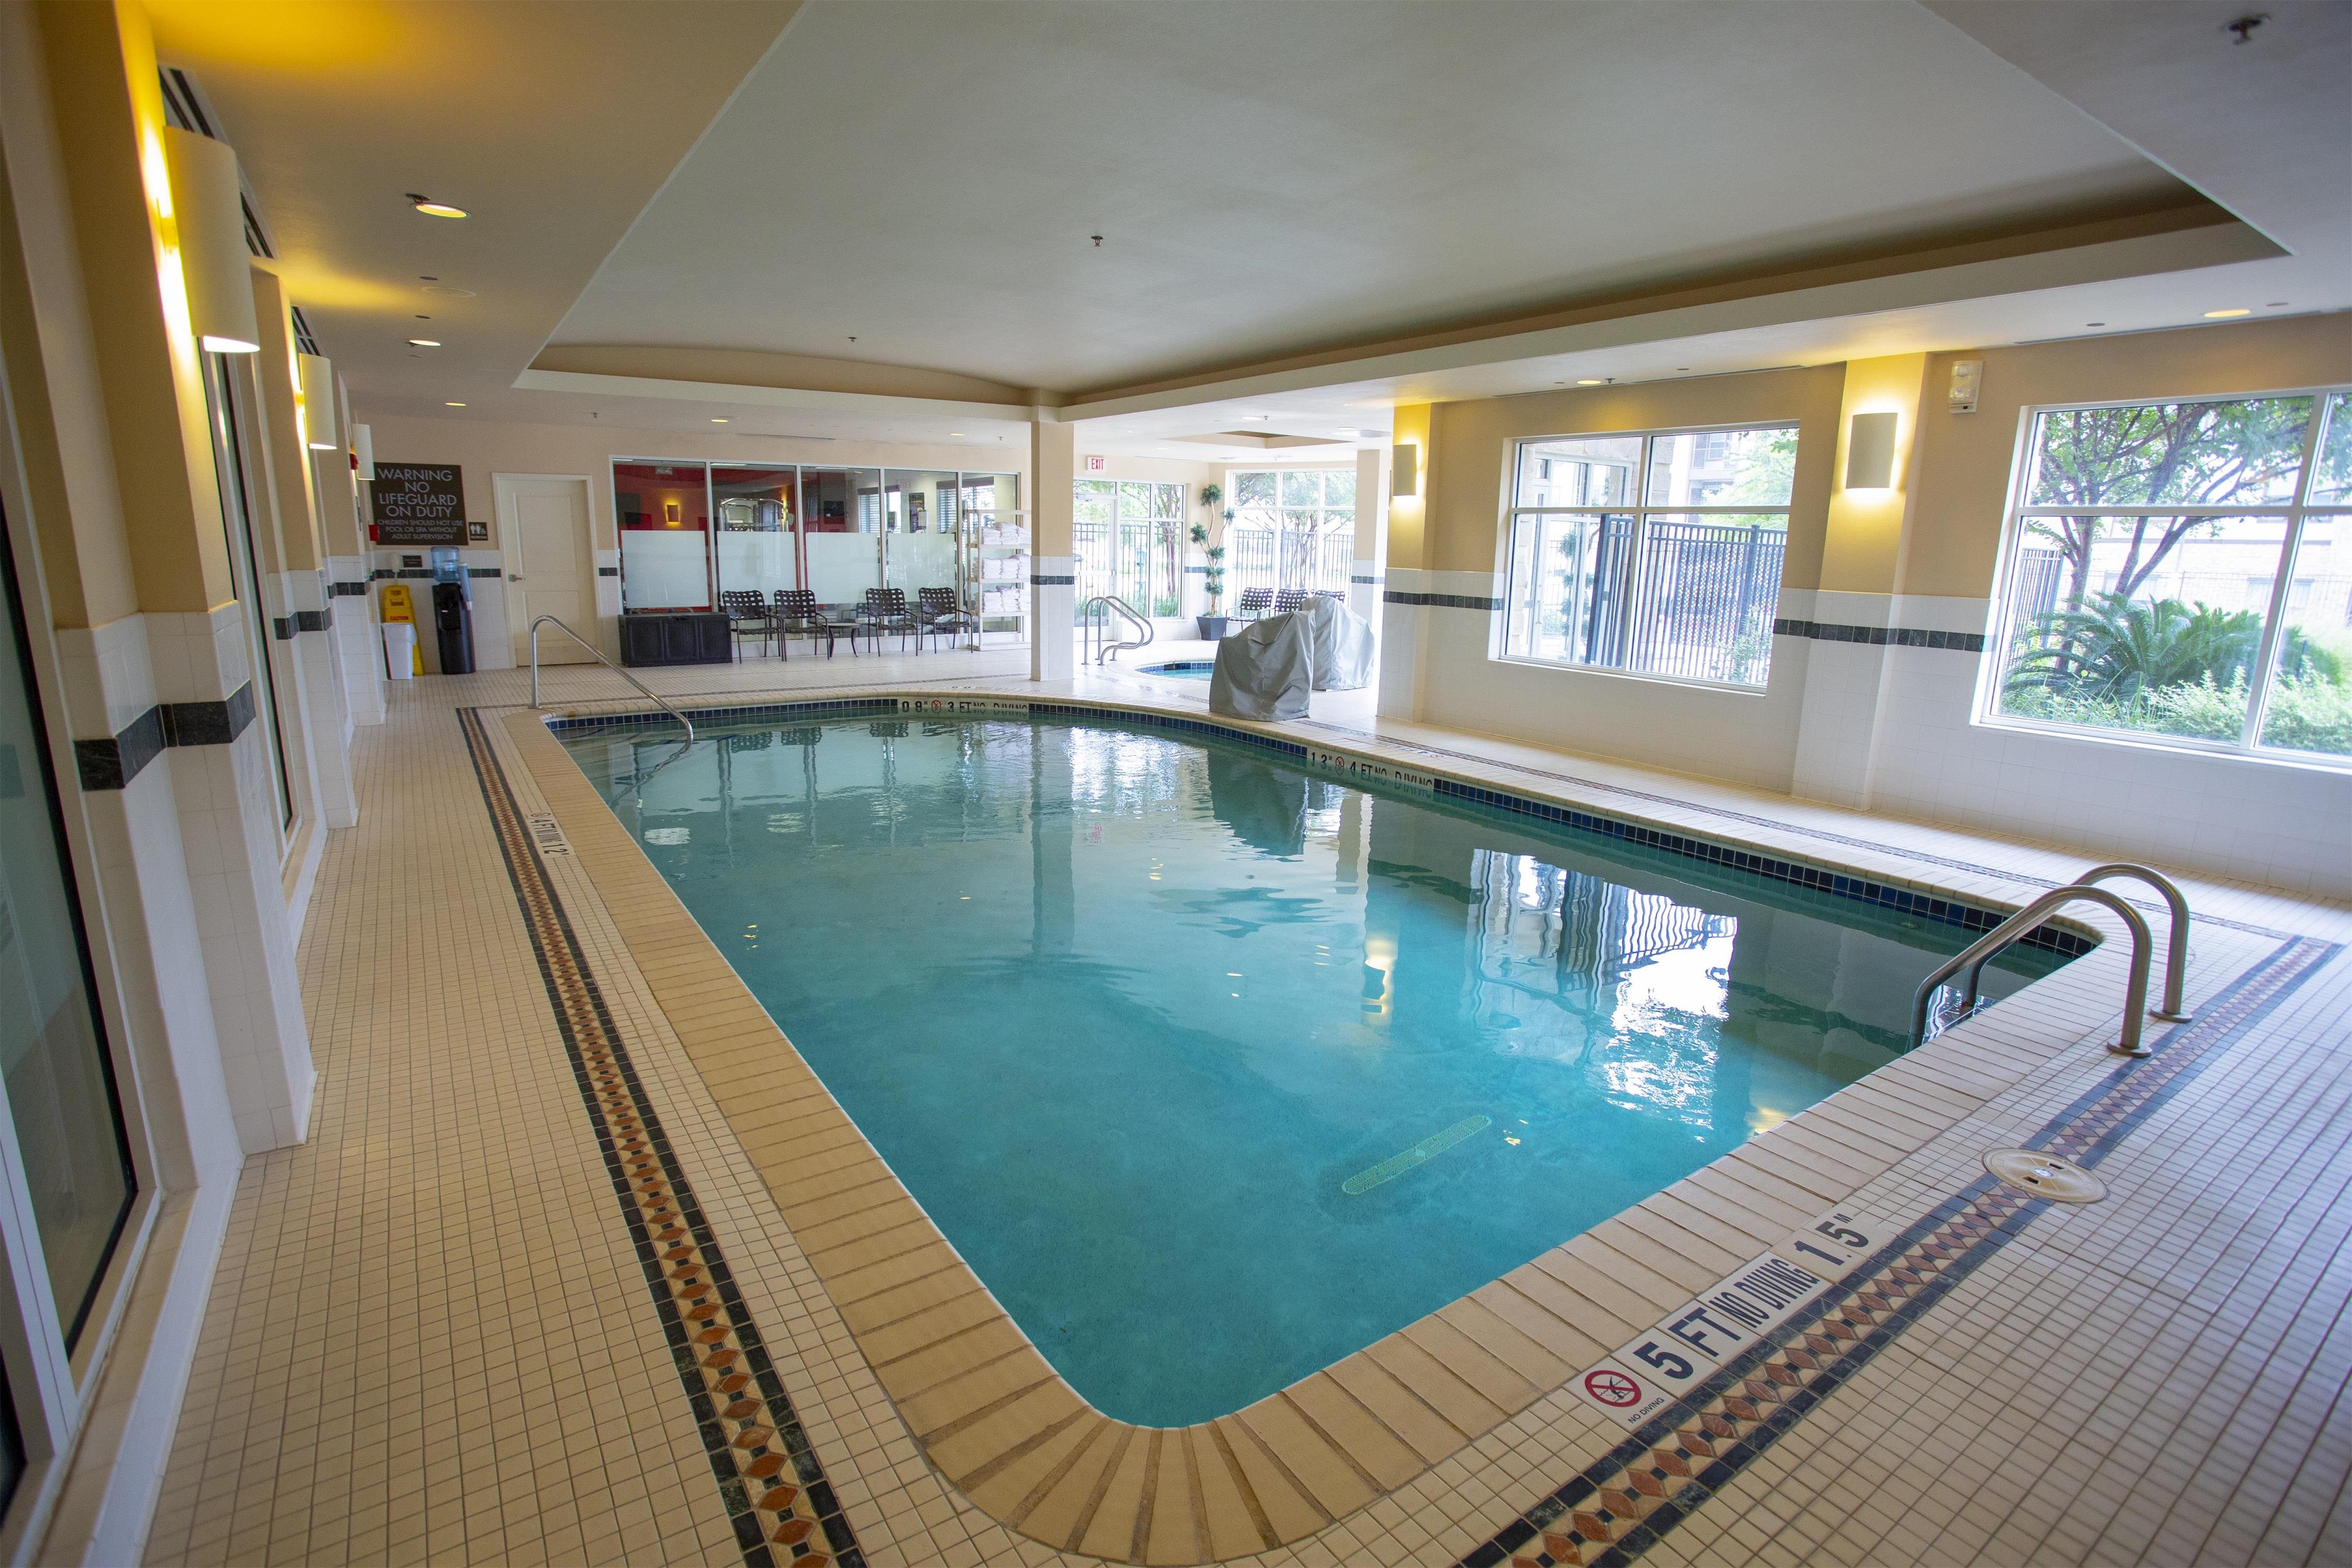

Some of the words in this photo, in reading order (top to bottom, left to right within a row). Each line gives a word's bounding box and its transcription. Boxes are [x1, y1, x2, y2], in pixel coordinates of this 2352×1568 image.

[1092, 458, 1104, 470] EXIT
[378, 468, 452, 481] WARNING
[405, 482, 430, 493] NO
[379, 493, 457, 505] LIFEGUARD
[386, 506, 410, 517] ON
[416, 506, 452, 517] DUTY
[1734, 1259, 1820, 1310] DIVING
[1708, 1292, 1769, 1328] NO
[1667, 1307, 1742, 1357] FT
[1633, 1341, 1694, 1380] 5
[1628, 1414, 1641, 1423] NO
[1639, 1397, 1665, 1415] DIVING
